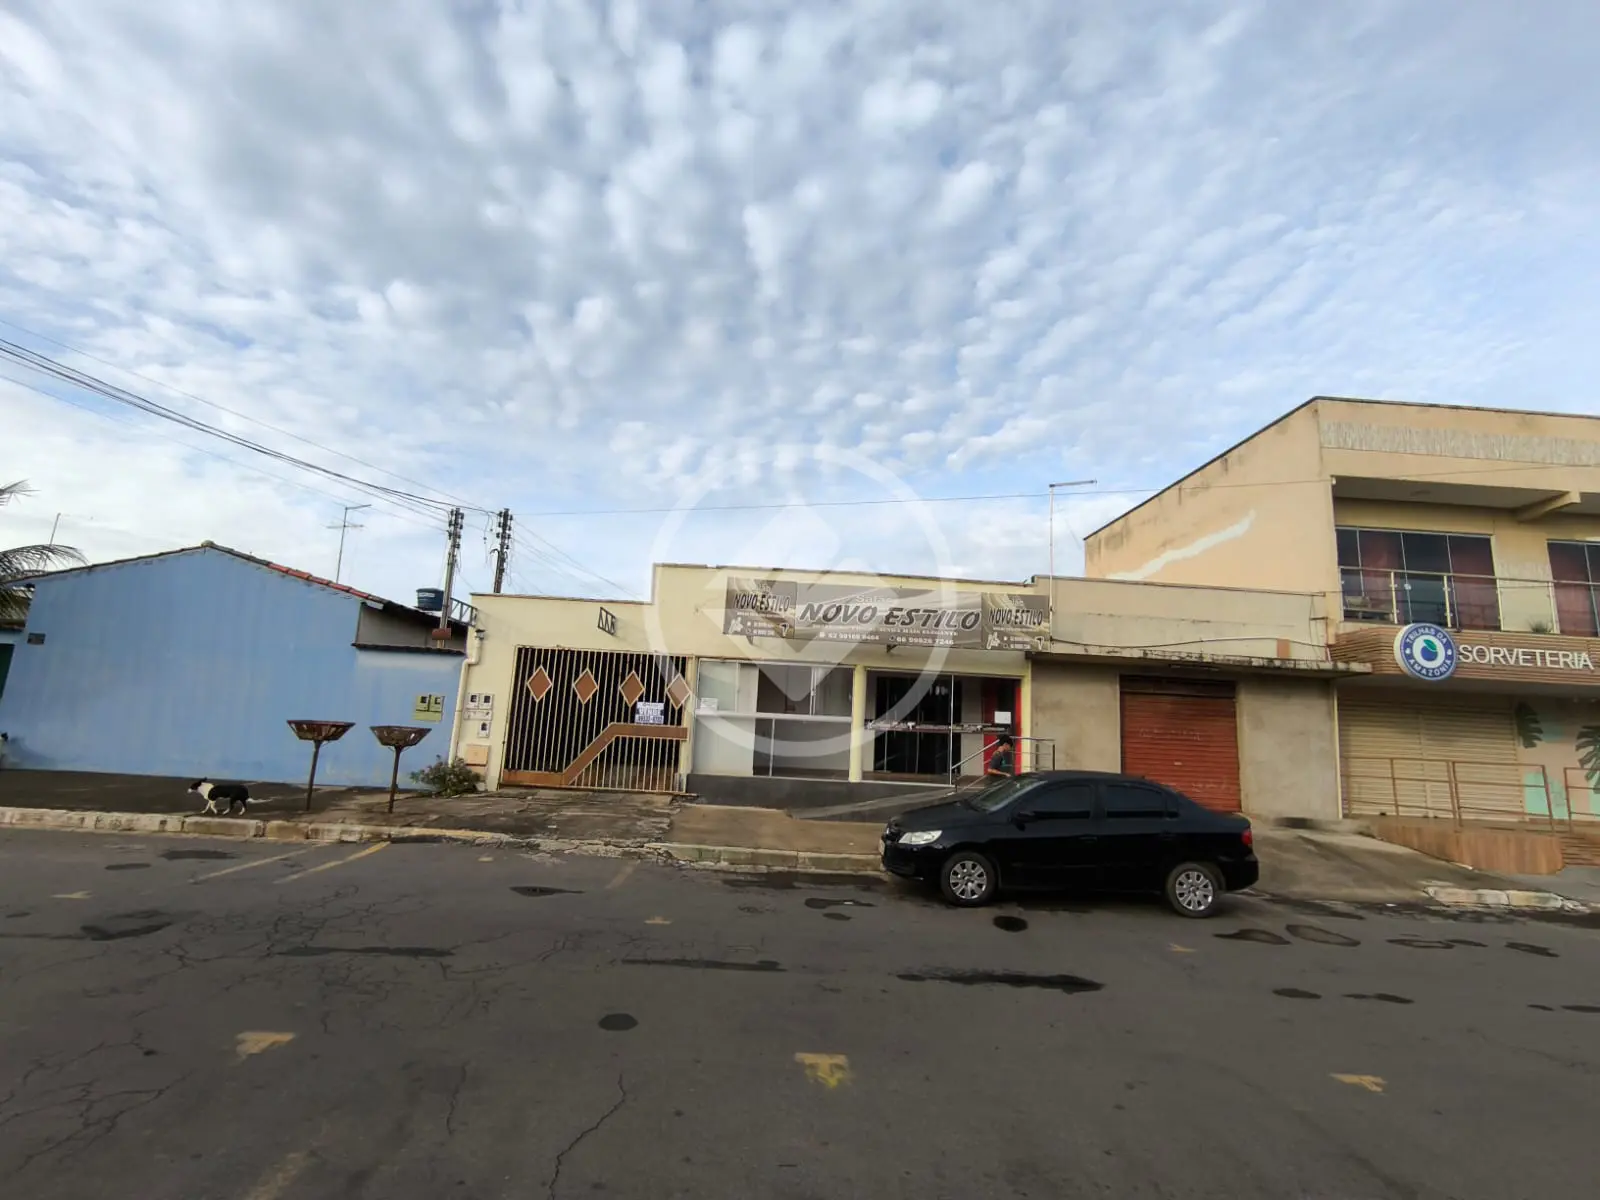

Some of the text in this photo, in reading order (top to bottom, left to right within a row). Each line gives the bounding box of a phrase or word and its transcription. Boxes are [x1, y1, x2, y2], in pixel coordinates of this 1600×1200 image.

[733, 592, 790, 612] NOVO ESTILO
[799, 602, 982, 631] NOVO ESTILO
[989, 607, 1043, 626] NOVO ESTILO
[1405, 627, 1447, 644] TRILHAS DA
[1458, 644, 1595, 670] SORVETERIA
